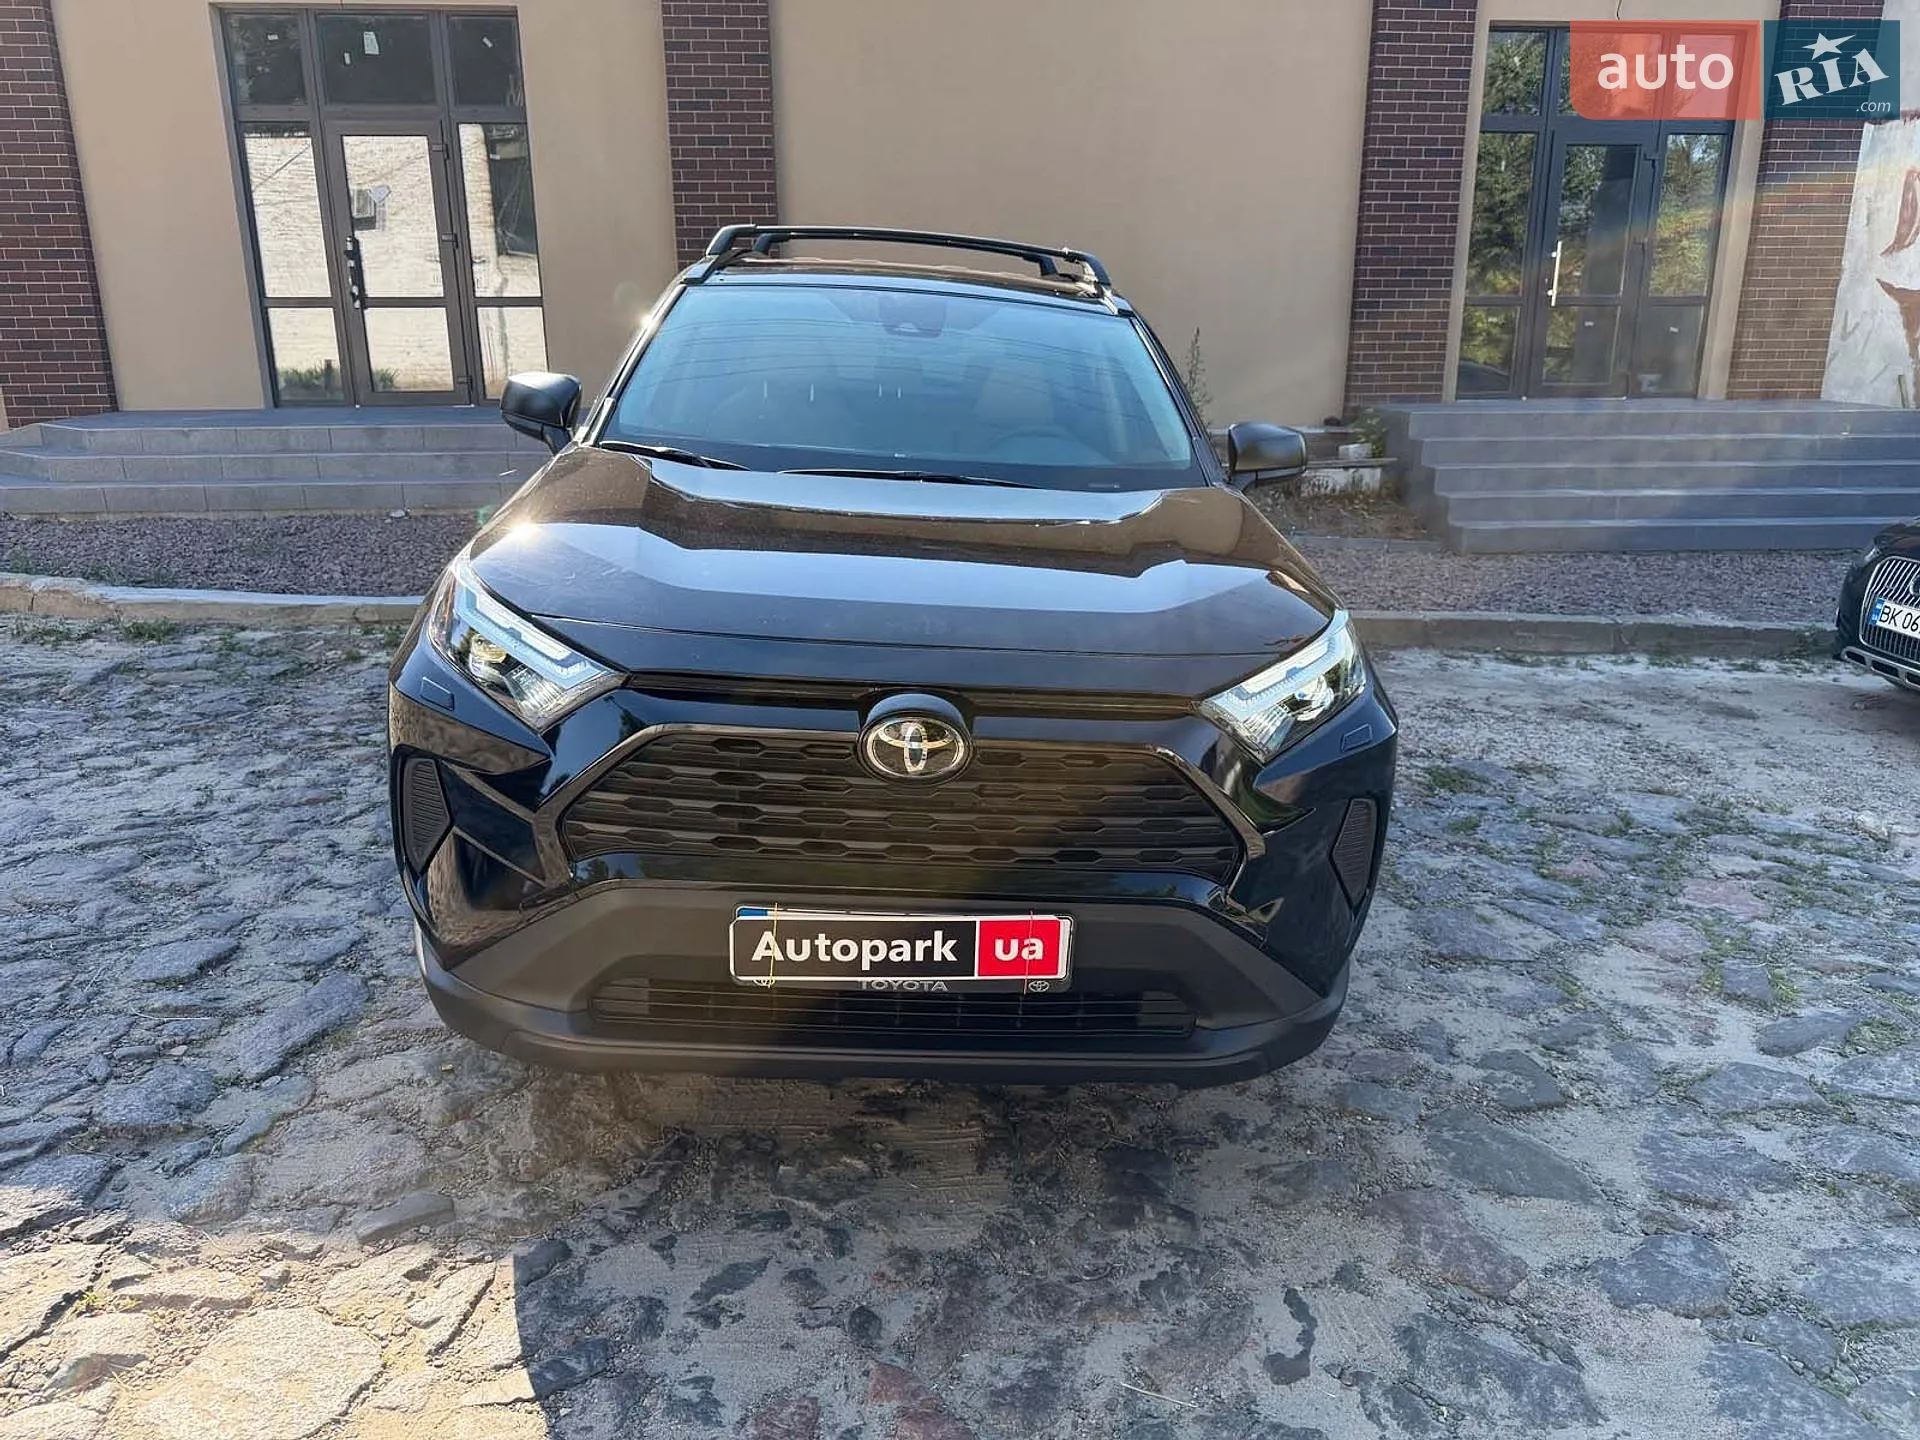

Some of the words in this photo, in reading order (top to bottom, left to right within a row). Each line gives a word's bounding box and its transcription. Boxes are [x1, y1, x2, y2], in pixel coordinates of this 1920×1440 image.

[1879, 604, 1903, 627] BK
[751, 930, 957, 971] Autopark
[994, 937, 1043, 961] ua
[858, 980, 949, 992] TOYOTA
